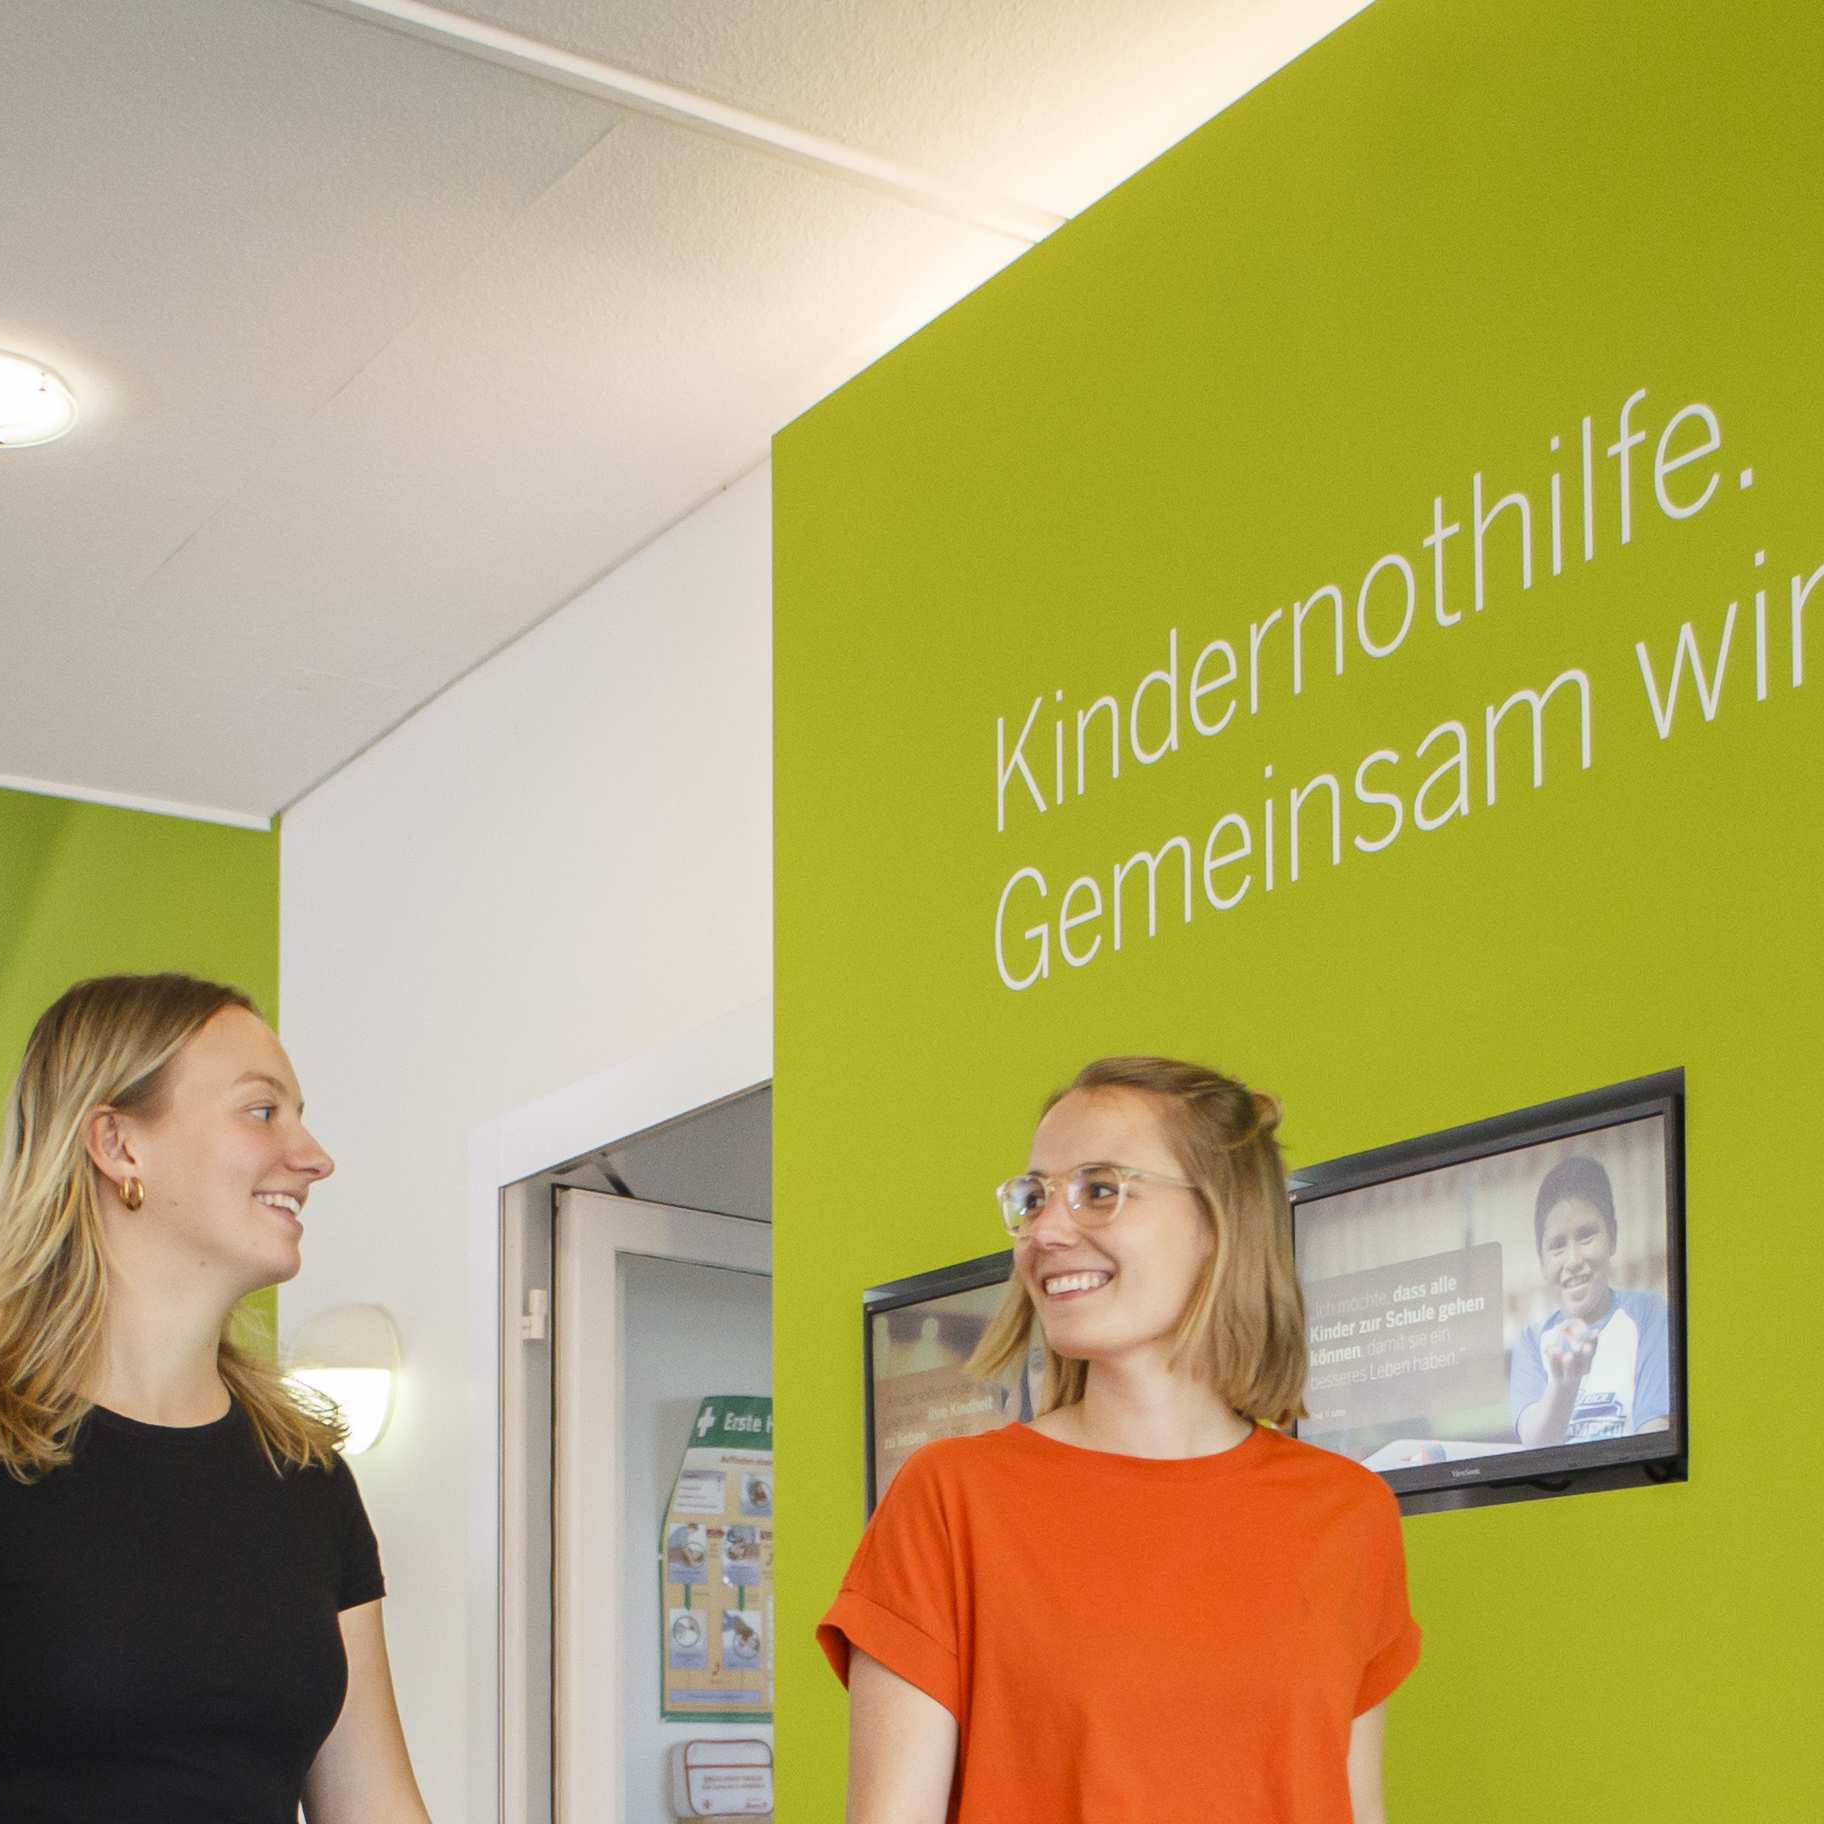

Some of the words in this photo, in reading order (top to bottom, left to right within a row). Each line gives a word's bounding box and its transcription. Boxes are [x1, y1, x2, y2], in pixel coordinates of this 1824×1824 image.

[994, 388, 1755, 832] Kindernothilfe.
[993, 667, 1593, 992] Gemeinsam
[1392, 1284, 1426, 1304] dass
[1429, 1274, 1458, 1295] alle
[1310, 1319, 1356, 1344] Kinder
[1358, 1315, 1382, 1335] zur
[1384, 1304, 1435, 1328] Schule
[1437, 1295, 1485, 1323] gehen
[1369, 1359, 1410, 1382] Leben
[723, 1411, 763, 1433] Erste
